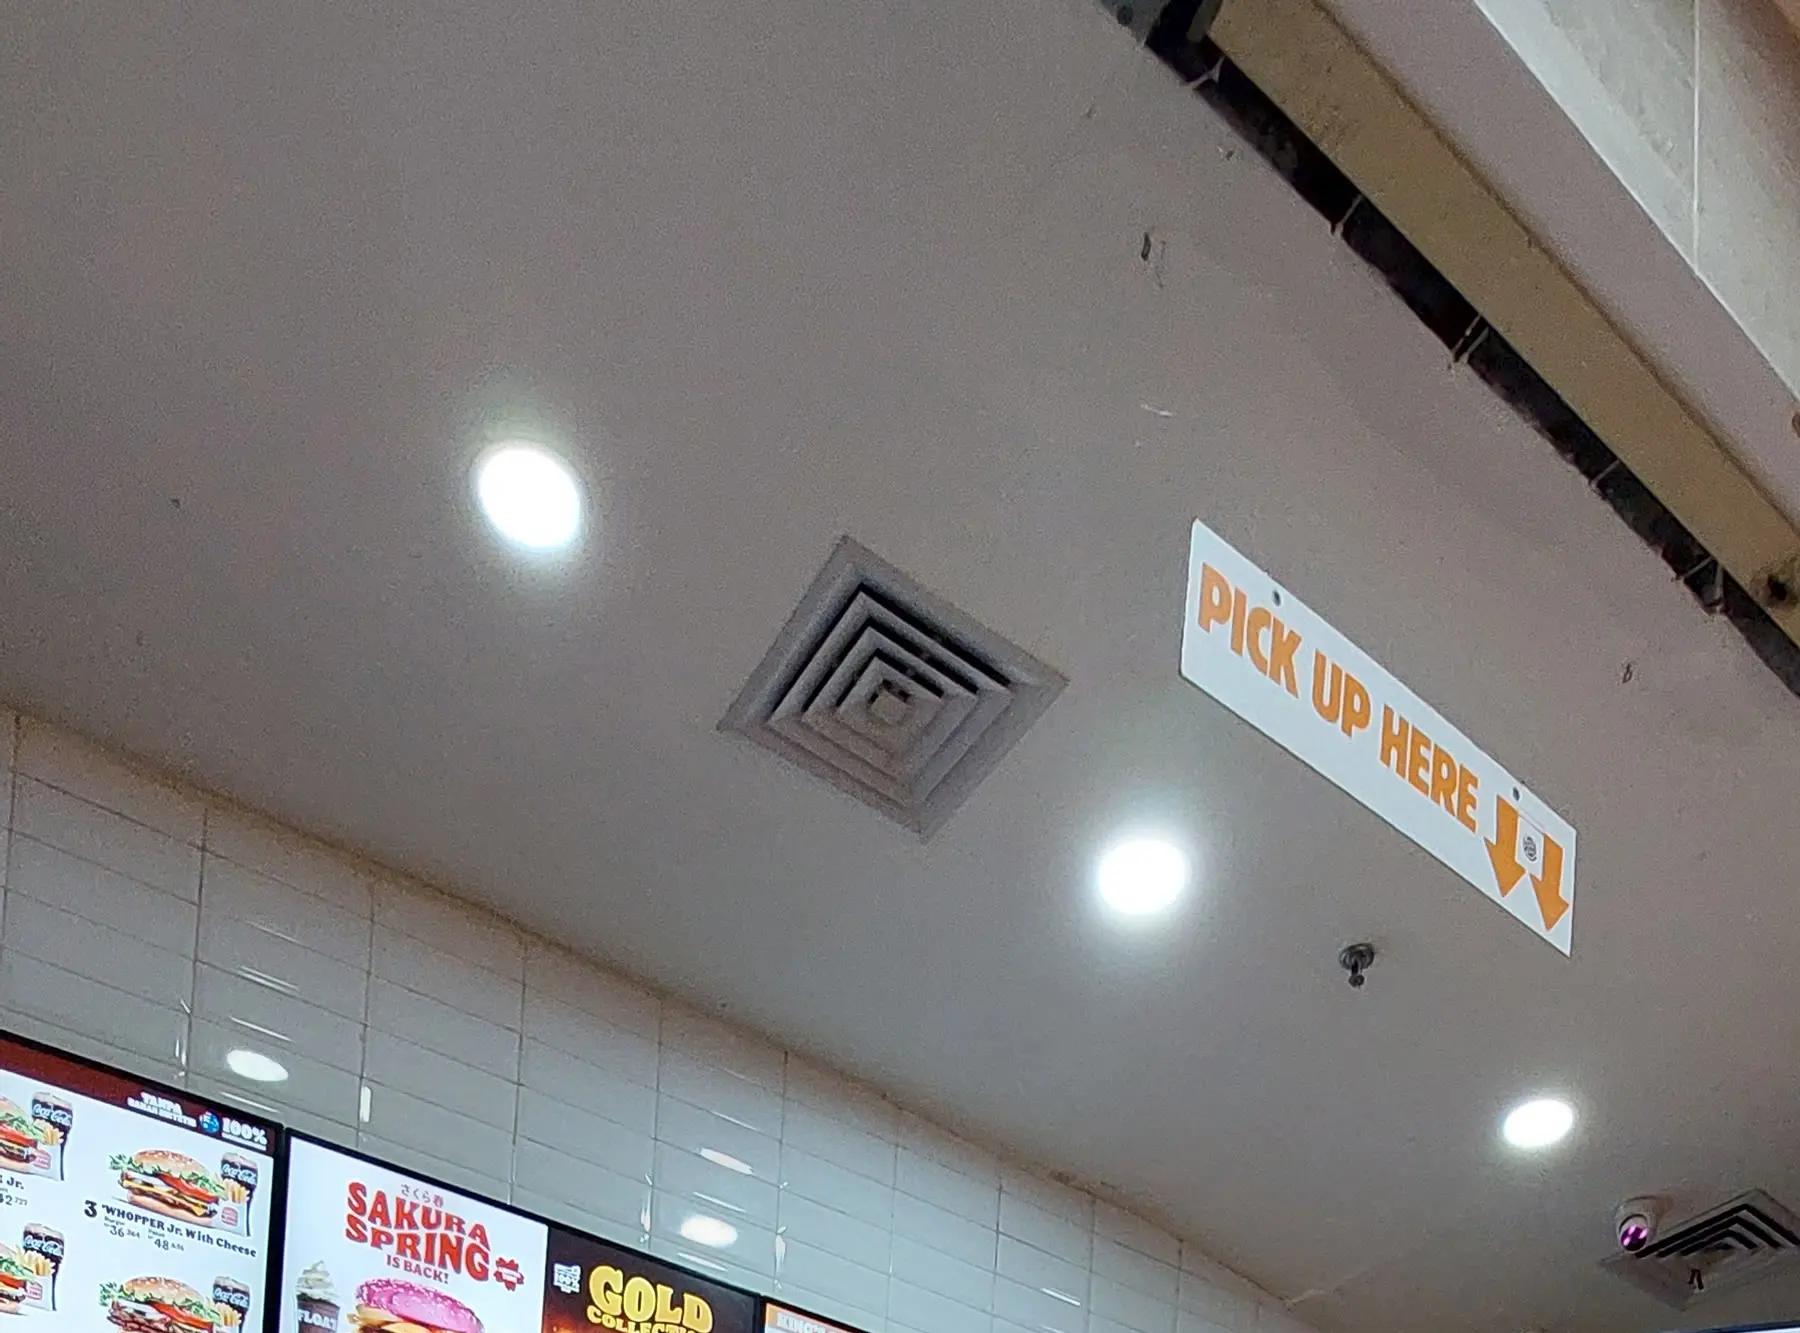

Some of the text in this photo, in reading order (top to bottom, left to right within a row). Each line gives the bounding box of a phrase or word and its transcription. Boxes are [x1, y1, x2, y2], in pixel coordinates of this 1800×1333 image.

[1198, 562, 1480, 834] PICK UP HERE
[222, 1117, 268, 1145] 100%
[84, 1200, 97, 1218] 3
[167, 1223, 183, 1236] Jr.
[186, 1228, 214, 1245] With
[216, 1238, 257, 1258] Cheese
[347, 1181, 491, 1252] SAKURA
[345, 1213, 490, 1282] SPRING
[386, 1254, 449, 1285] IS BACK!
[298, 1309, 337, 1332] FLOAT
